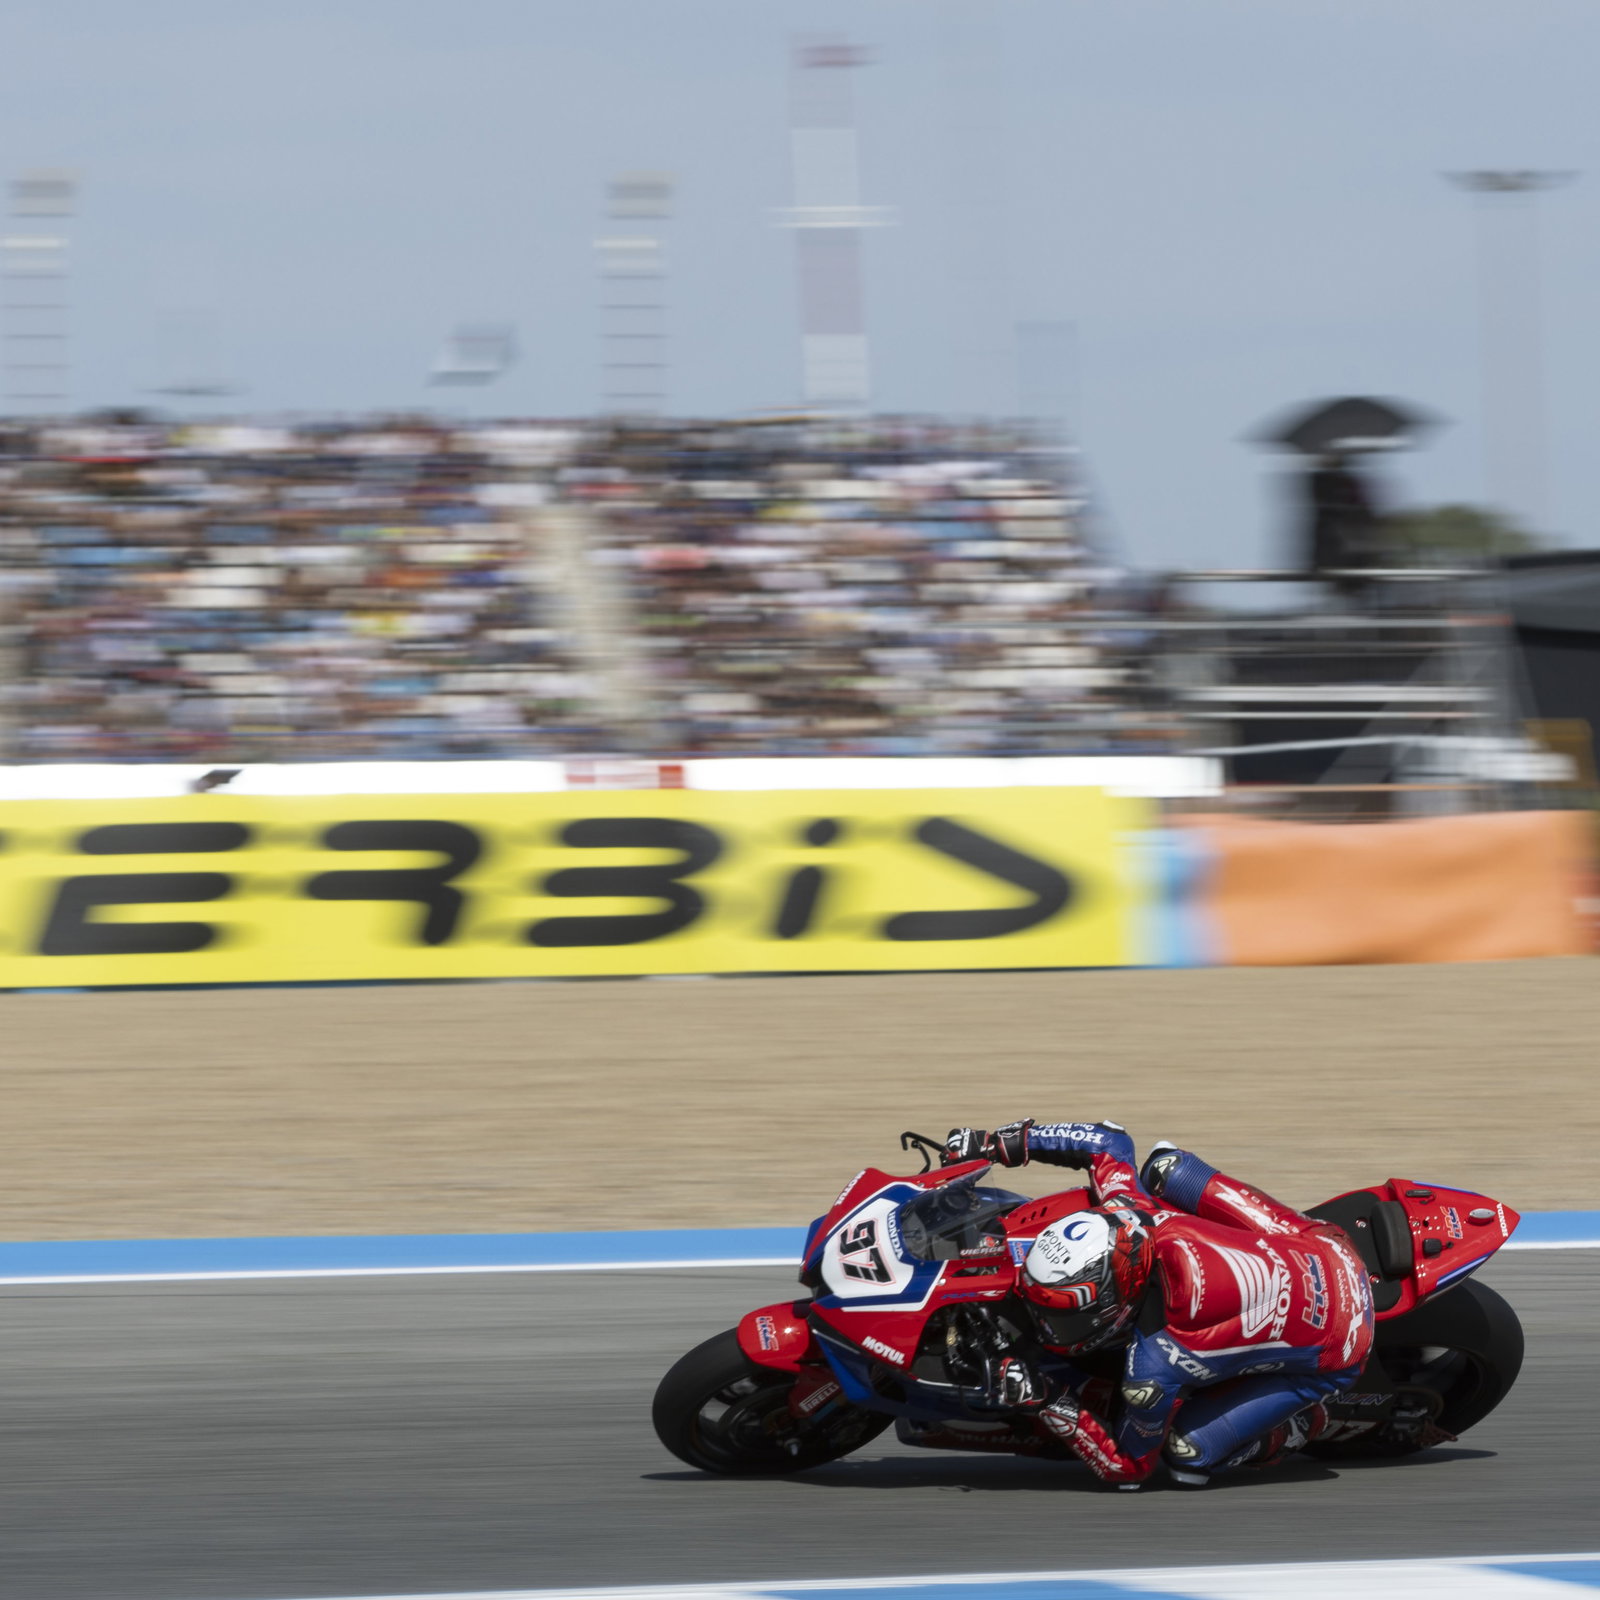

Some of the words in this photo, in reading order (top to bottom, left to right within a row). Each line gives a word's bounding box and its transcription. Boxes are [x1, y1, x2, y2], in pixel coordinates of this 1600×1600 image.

[0, 815, 1077, 956] ERBIS
[1027, 1127, 1104, 1144] HONDA
[887, 1210, 904, 1261] HONDA
[1496, 1202, 1509, 1238] HONDA
[838, 1217, 897, 1286] 97
[1037, 1239, 1061, 1266] GRUP
[1047, 1230, 1071, 1258] PONT
[1256, 1238, 1292, 1341] HONDA
[861, 1335, 906, 1366] MOTUL
